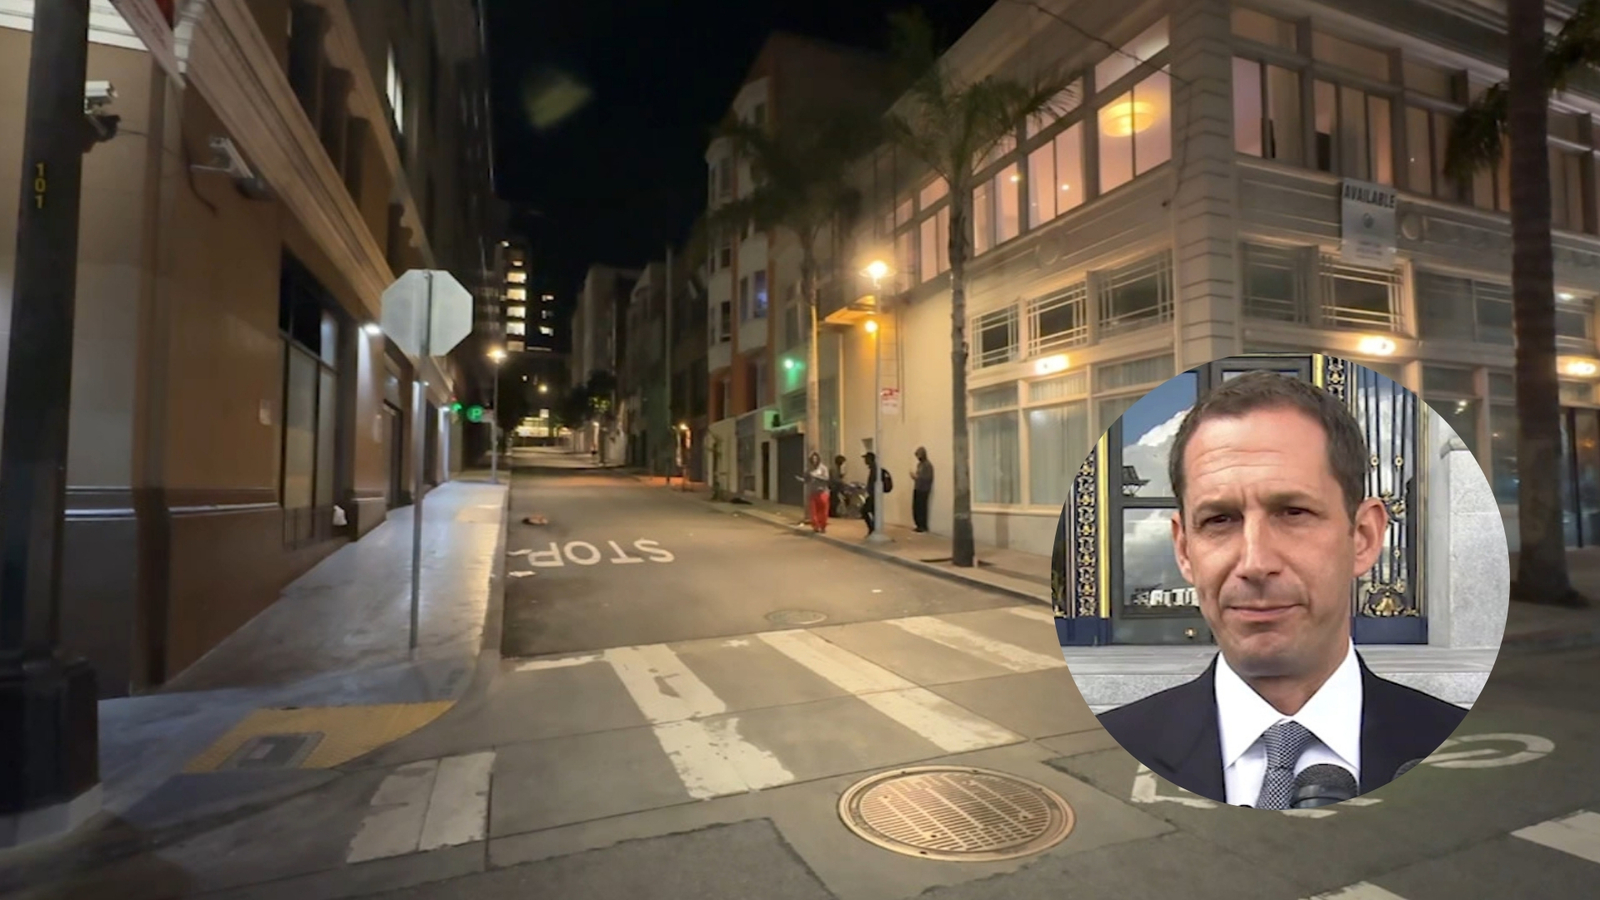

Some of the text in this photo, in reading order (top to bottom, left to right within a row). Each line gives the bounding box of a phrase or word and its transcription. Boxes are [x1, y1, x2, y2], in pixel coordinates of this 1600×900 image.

[35, 163, 46, 209] 101
[1344, 184, 1396, 209] AVAILABLE
[527, 539, 675, 567] STOP
